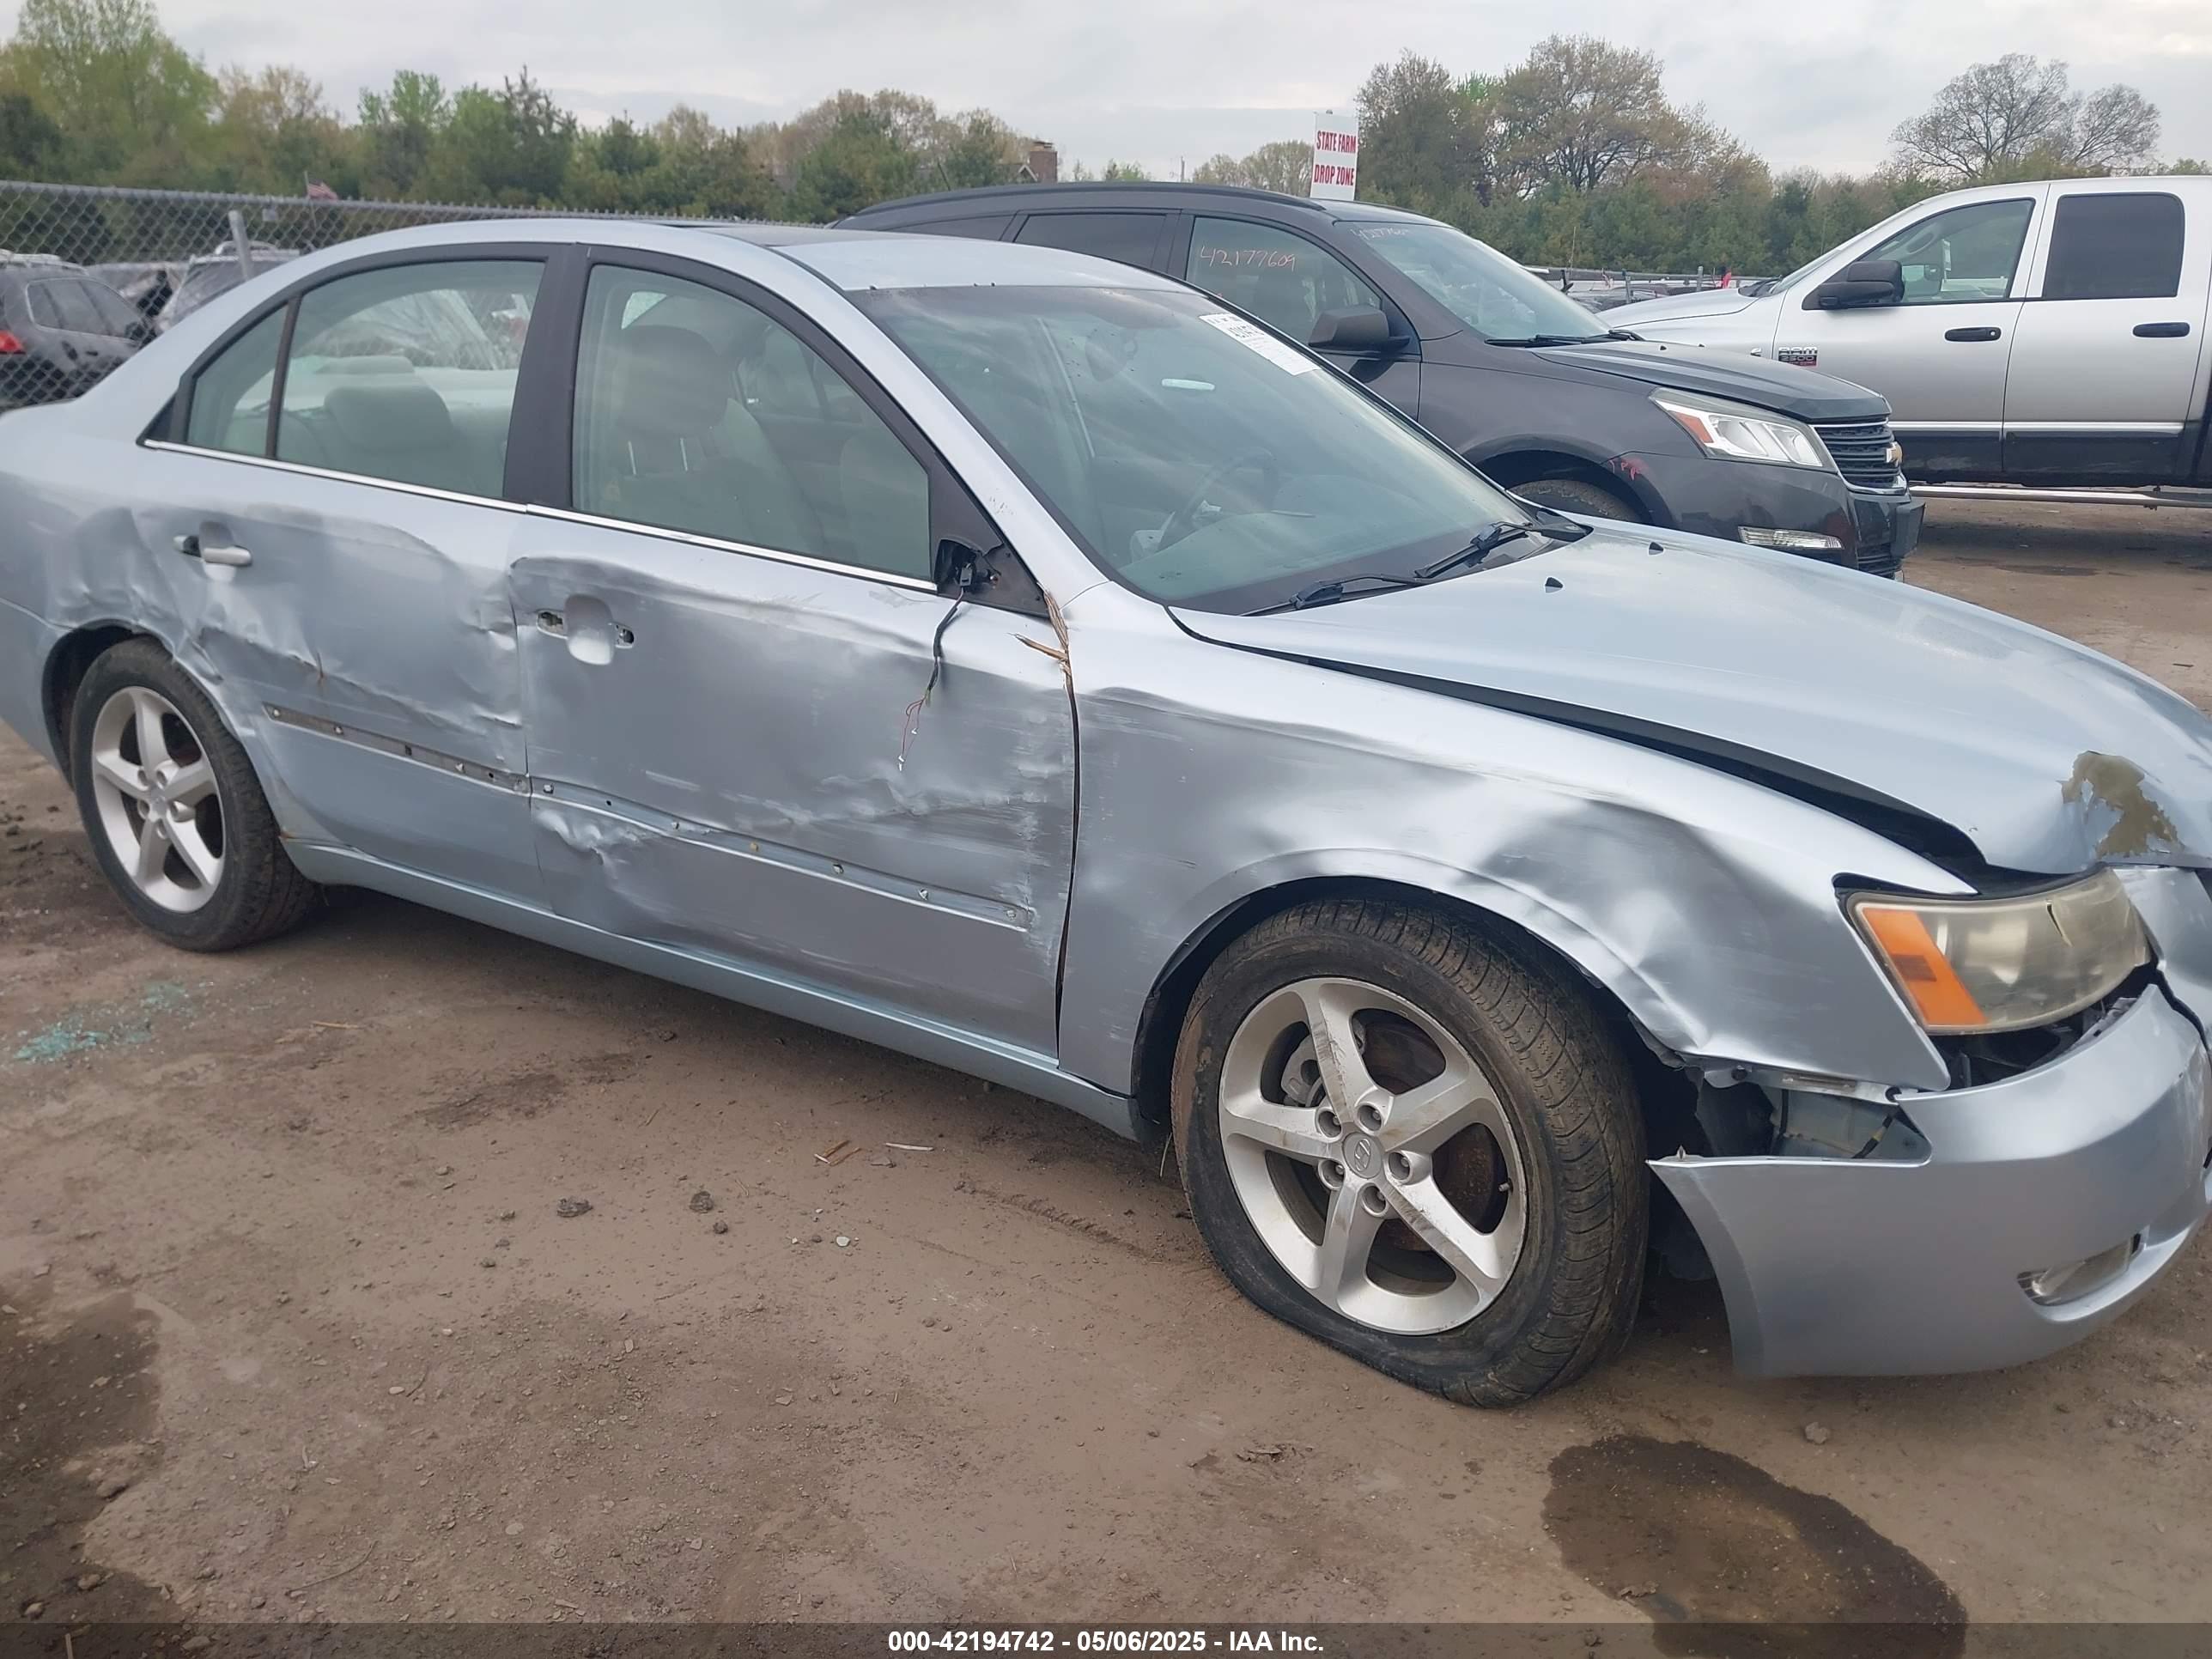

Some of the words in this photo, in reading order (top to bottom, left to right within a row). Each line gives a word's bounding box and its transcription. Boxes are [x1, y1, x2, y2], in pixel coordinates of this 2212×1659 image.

[1316, 131, 1337, 151] STATE
[1338, 133, 1356, 154] FARM
[1314, 164, 1335, 185] DROP
[1336, 166, 1354, 185] ZONE
[1200, 245, 1295, 272] 42177609
[1778, 347, 1817, 356] RAM
